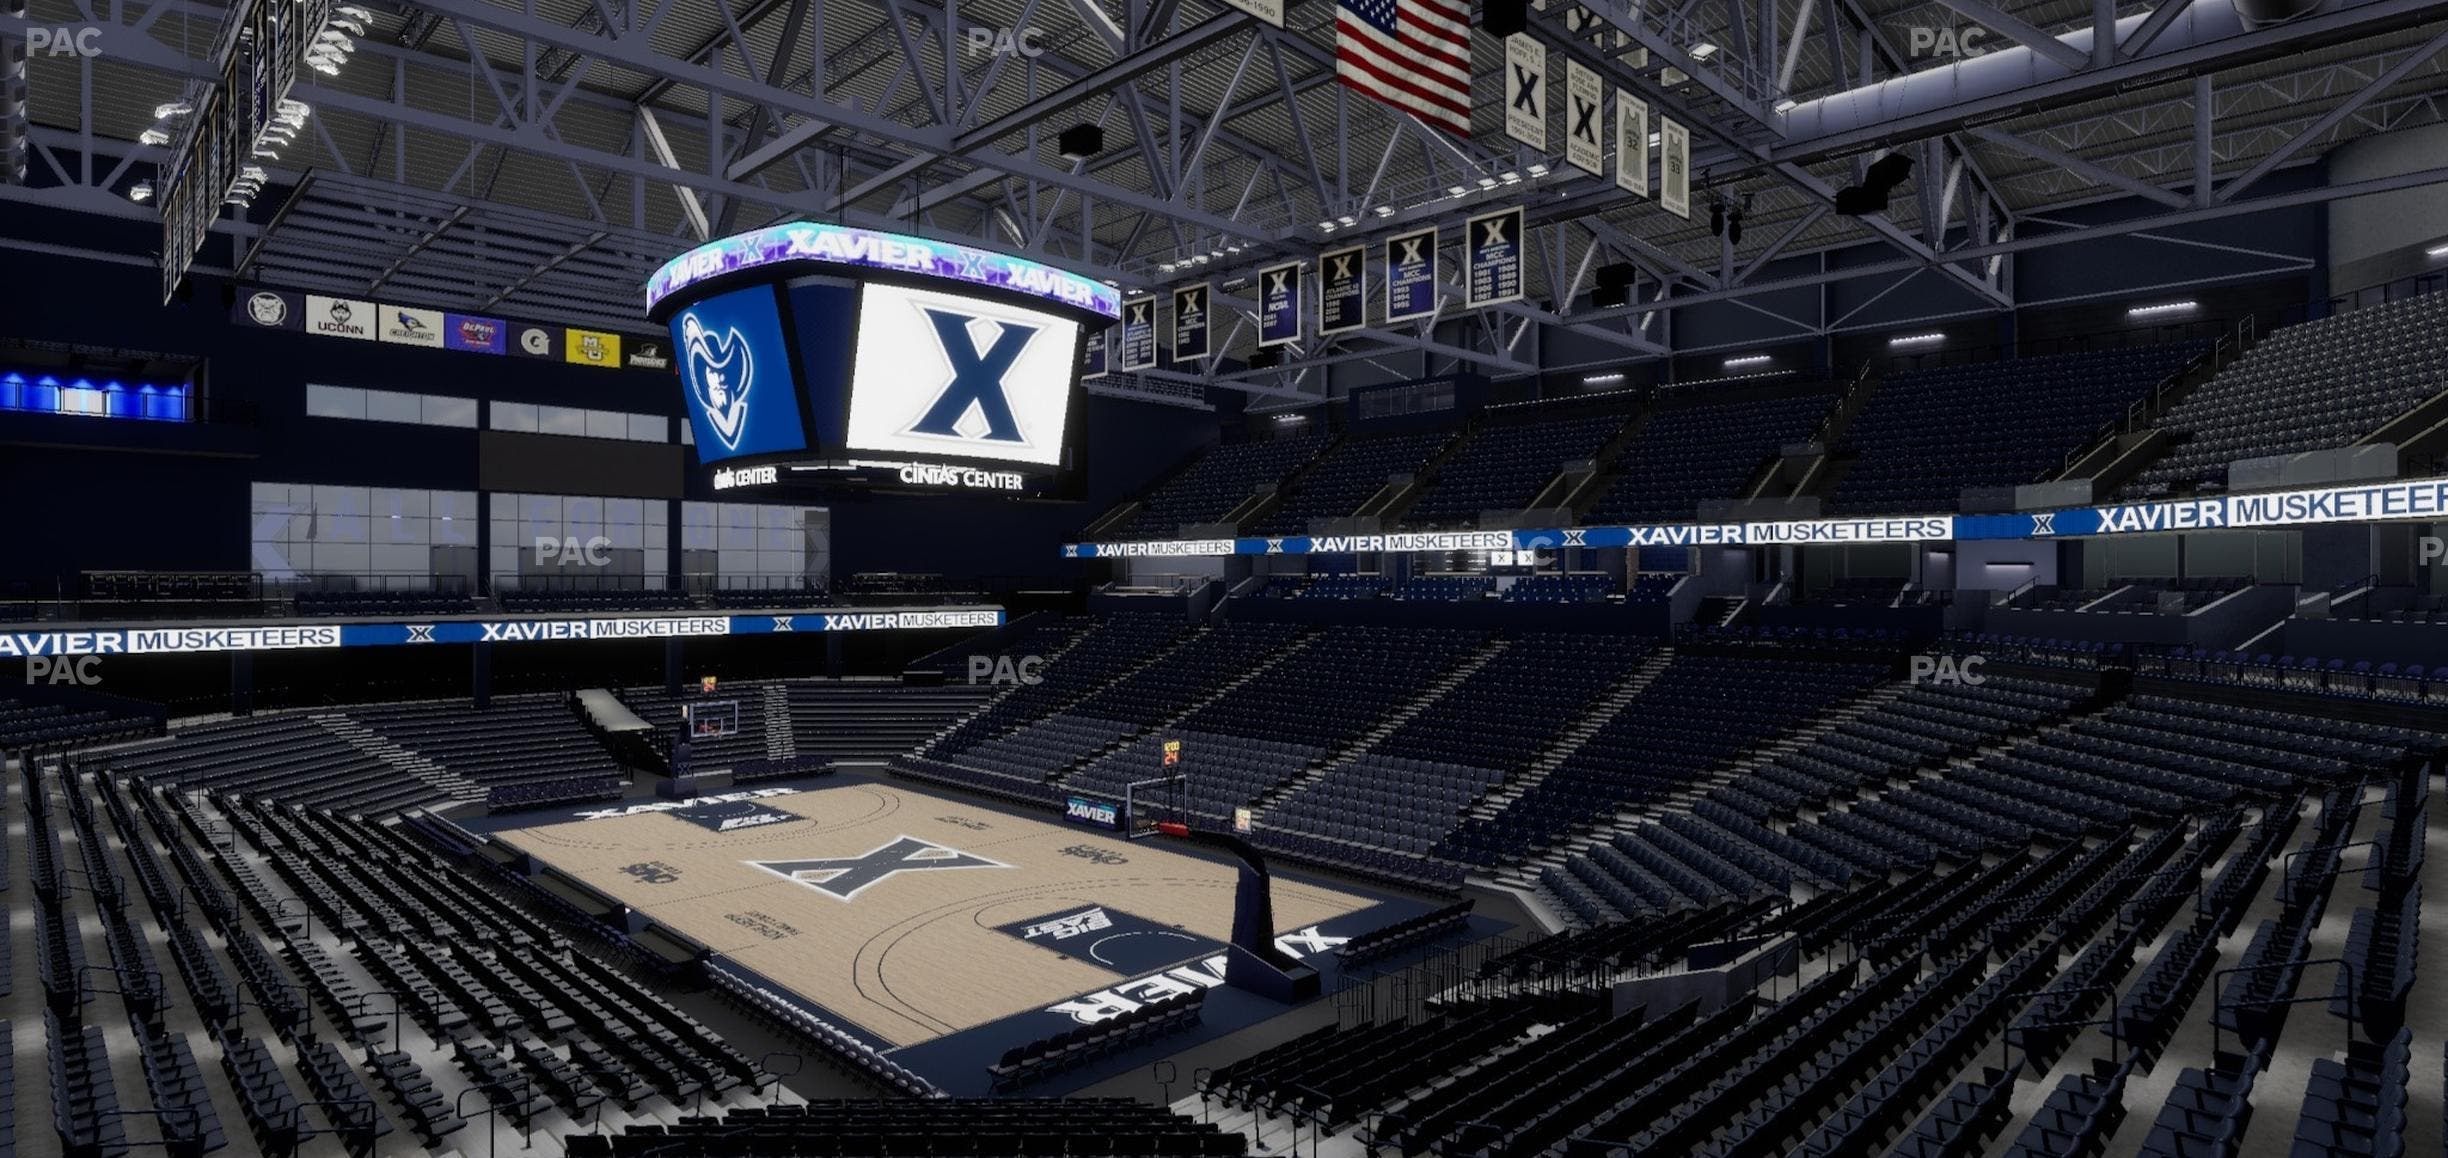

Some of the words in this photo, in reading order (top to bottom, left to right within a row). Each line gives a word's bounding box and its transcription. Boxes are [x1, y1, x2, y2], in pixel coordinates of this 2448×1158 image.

[1512, 62, 1540, 120] X
[1572, 94, 1598, 146] X
[1626, 137, 1639, 151] 32
[1670, 162, 1681, 175] 33
[1481, 217, 1509, 248] X
[741, 236, 764, 264] X
[786, 229, 935, 270] XAVIER
[1400, 236, 1425, 265] X
[1485, 250, 1504, 261] MCC
[669, 248, 724, 288] XAVIER
[961, 252, 987, 280] X
[1333, 255, 1353, 280] X
[1403, 269, 1421, 279] MCC
[1473, 255, 1517, 270] CHAMPIONS
[1007, 262, 1094, 306] XAVIER
[1268, 271, 1290, 296] X
[1392, 274, 1432, 287] CHAMPIONS
[1184, 291, 1199, 314] X
[1132, 304, 1146, 326] X
[317, 321, 364, 335] UCONN
[900, 303, 1046, 447] X
[736, 466, 778, 487] CENTER
[963, 471, 1024, 490] CENTER
[2031, 513, 2056, 535] X
[2097, 500, 2224, 533] XAVIER
[1310, 536, 1384, 552] XAVIER
[1390, 533, 1508, 550] MUSKETEERS
[1562, 529, 1587, 546] X
[1627, 525, 1743, 545] XAVIER
[1753, 519, 1946, 541] MUSKETEERS
[1096, 543, 1148, 557] XAVIER
[1151, 540, 1232, 555] MUSKETEERS
[480, 622, 588, 642] XAVIER
[596, 619, 726, 636] MUSKETEERS
[772, 616, 794, 632] X
[824, 614, 898, 631] XAVIER
[902, 612, 995, 627] MUSKETEERS
[137, 625, 335, 650] MUSKETEERS
[406, 625, 436, 642] X
[1164, 752, 1179, 766] 24
[1067, 802, 1116, 825] XAVIER
[737, 834, 1021, 903] X
[1021, 907, 1106, 939] EAST
[1053, 917, 1113, 940] BIG
